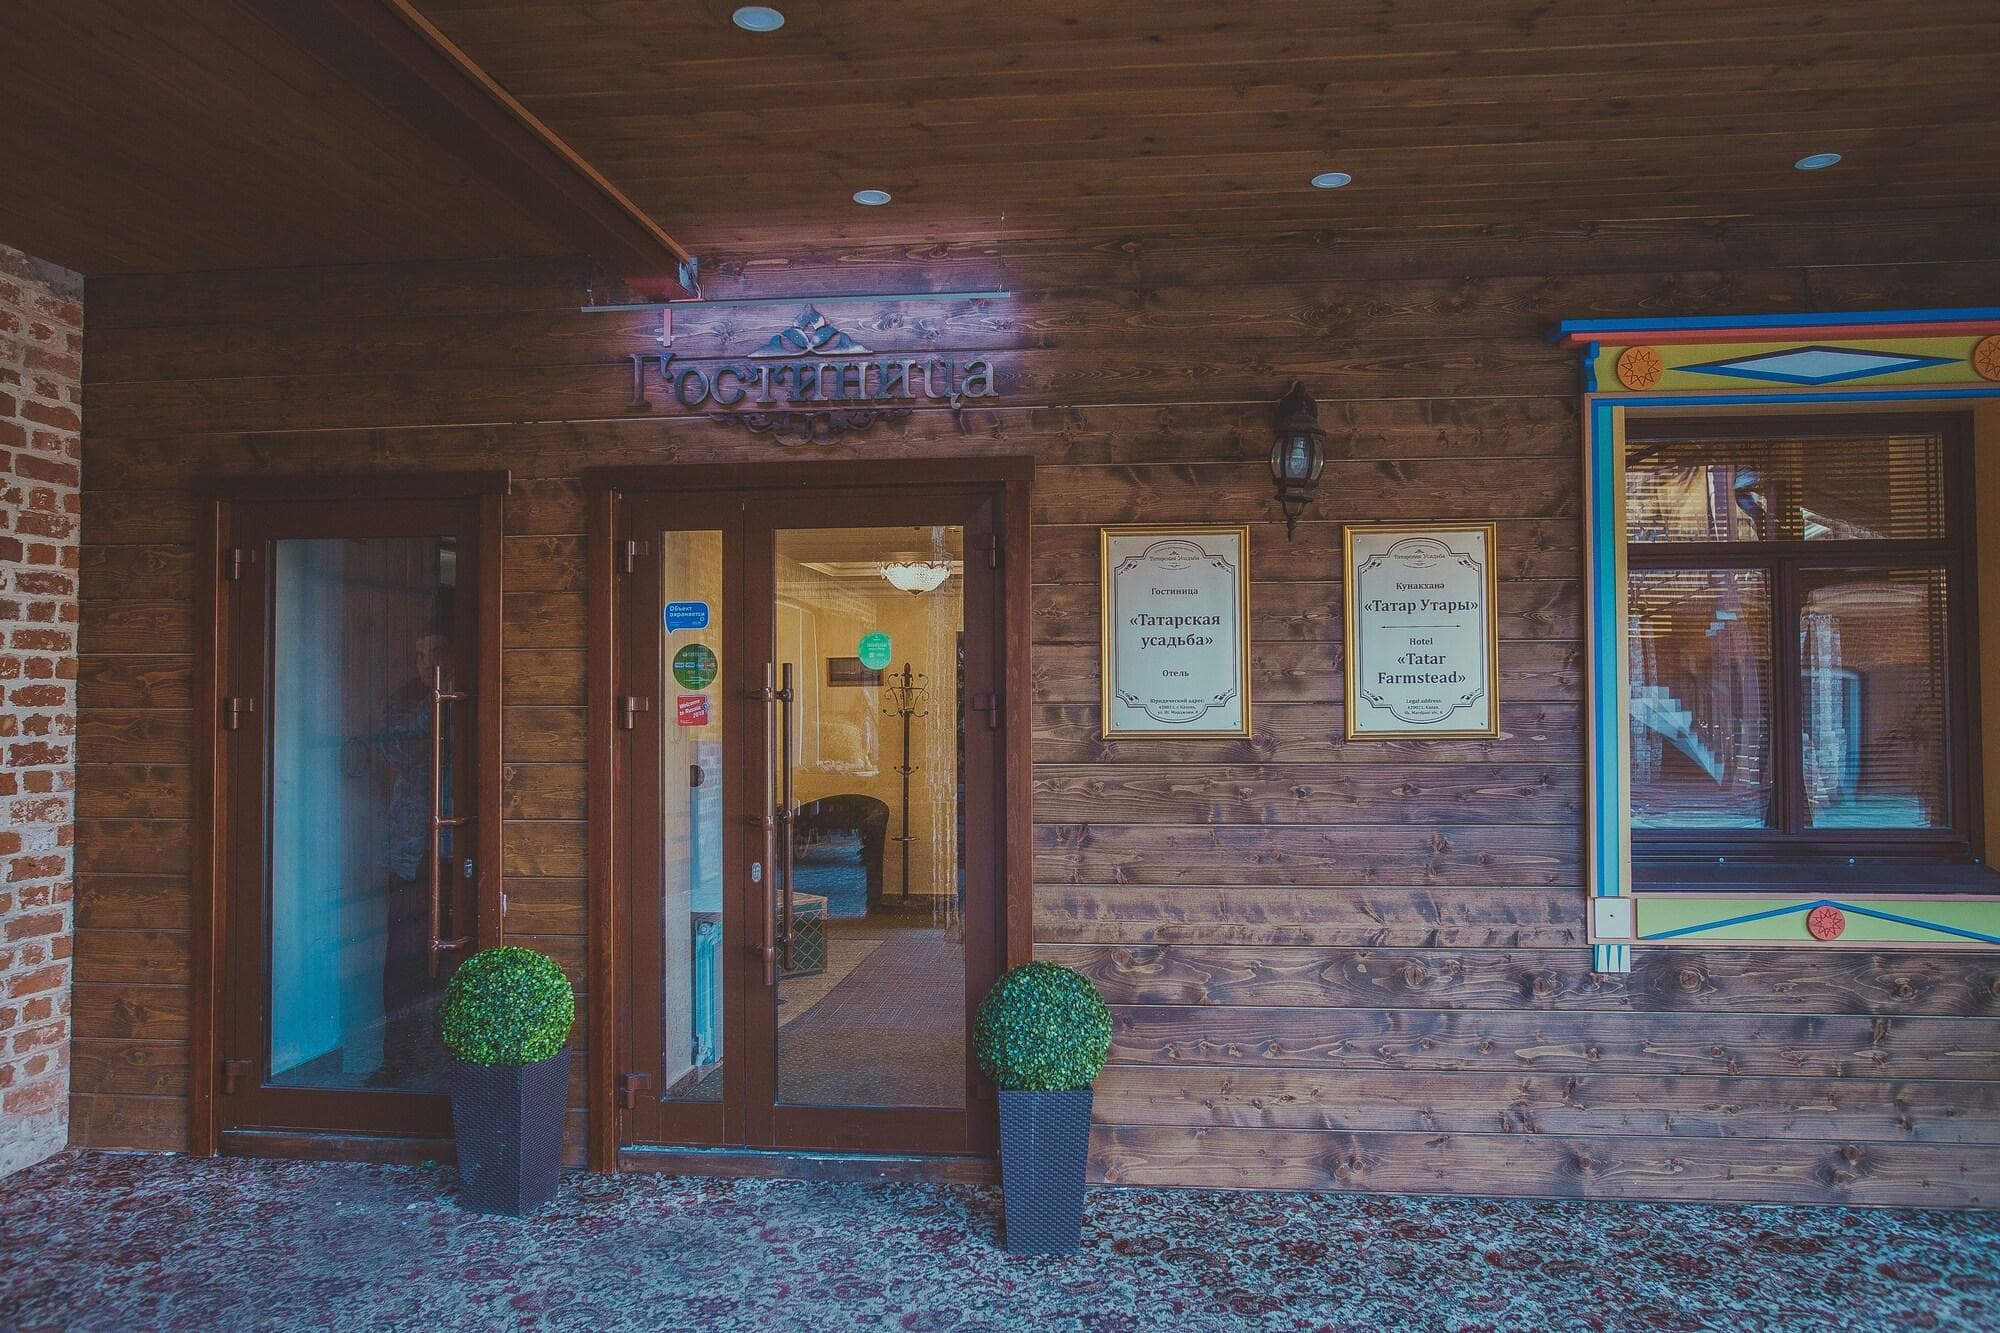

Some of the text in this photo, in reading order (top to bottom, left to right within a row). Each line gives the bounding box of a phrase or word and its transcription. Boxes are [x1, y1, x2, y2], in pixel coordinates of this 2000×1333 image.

[629, 352, 999, 410] Гостиница
[1151, 587, 1198, 596] Гостиница
[1364, 599, 1478, 614] «Татар Утары»
[1129, 613, 1220, 629] «Татарская
[1141, 633, 1213, 649] усадьба»
[1409, 638, 1433, 646] Hotel
[1397, 653, 1446, 665] «Tatar
[1162, 669, 1190, 677] Отель
[1377, 671, 1466, 684] Farmstead»
[679, 699, 701, 709] Welcome
